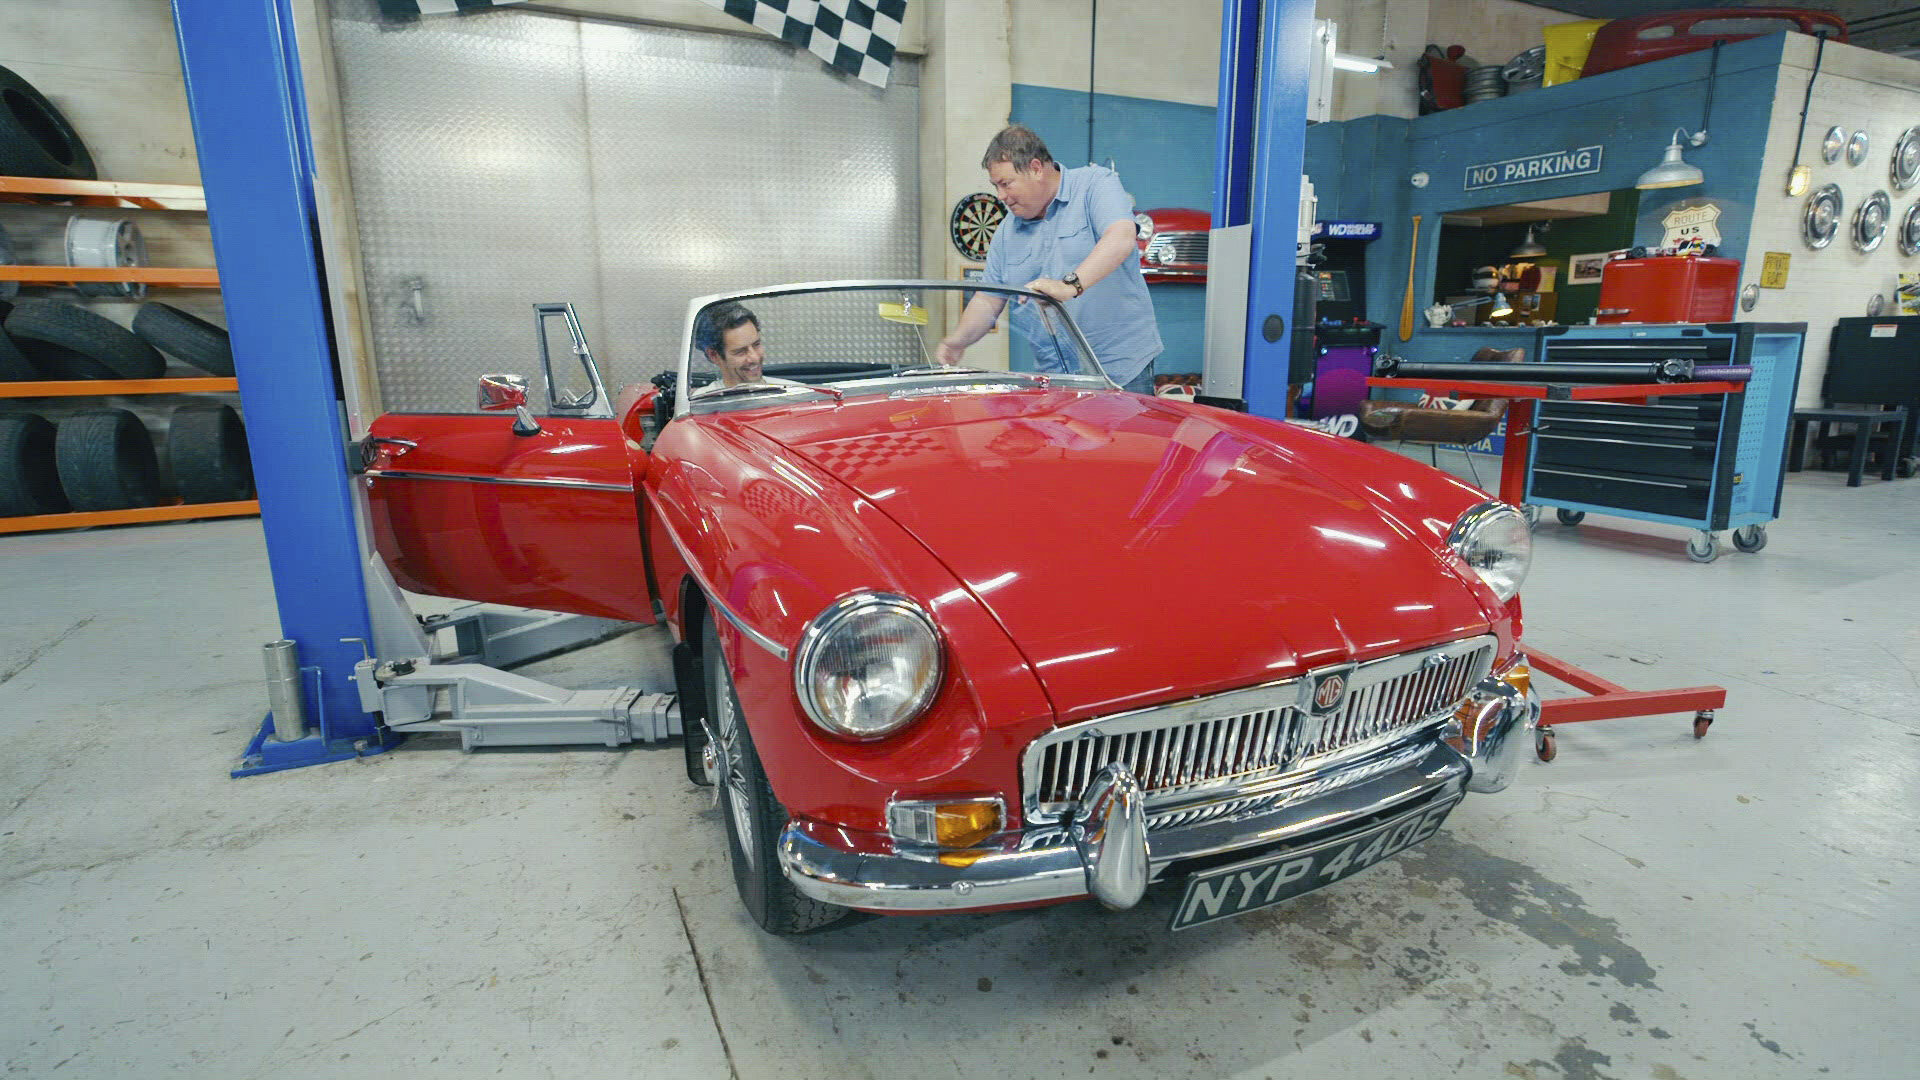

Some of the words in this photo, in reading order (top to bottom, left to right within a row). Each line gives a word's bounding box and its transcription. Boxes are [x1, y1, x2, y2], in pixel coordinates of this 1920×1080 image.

[1473, 167, 1498, 185] NO
[1504, 151, 1591, 180] PARKING
[1674, 211, 1707, 225] ROUTE
[1318, 678, 1342, 705] MG
[1182, 856, 1314, 924] NYP
